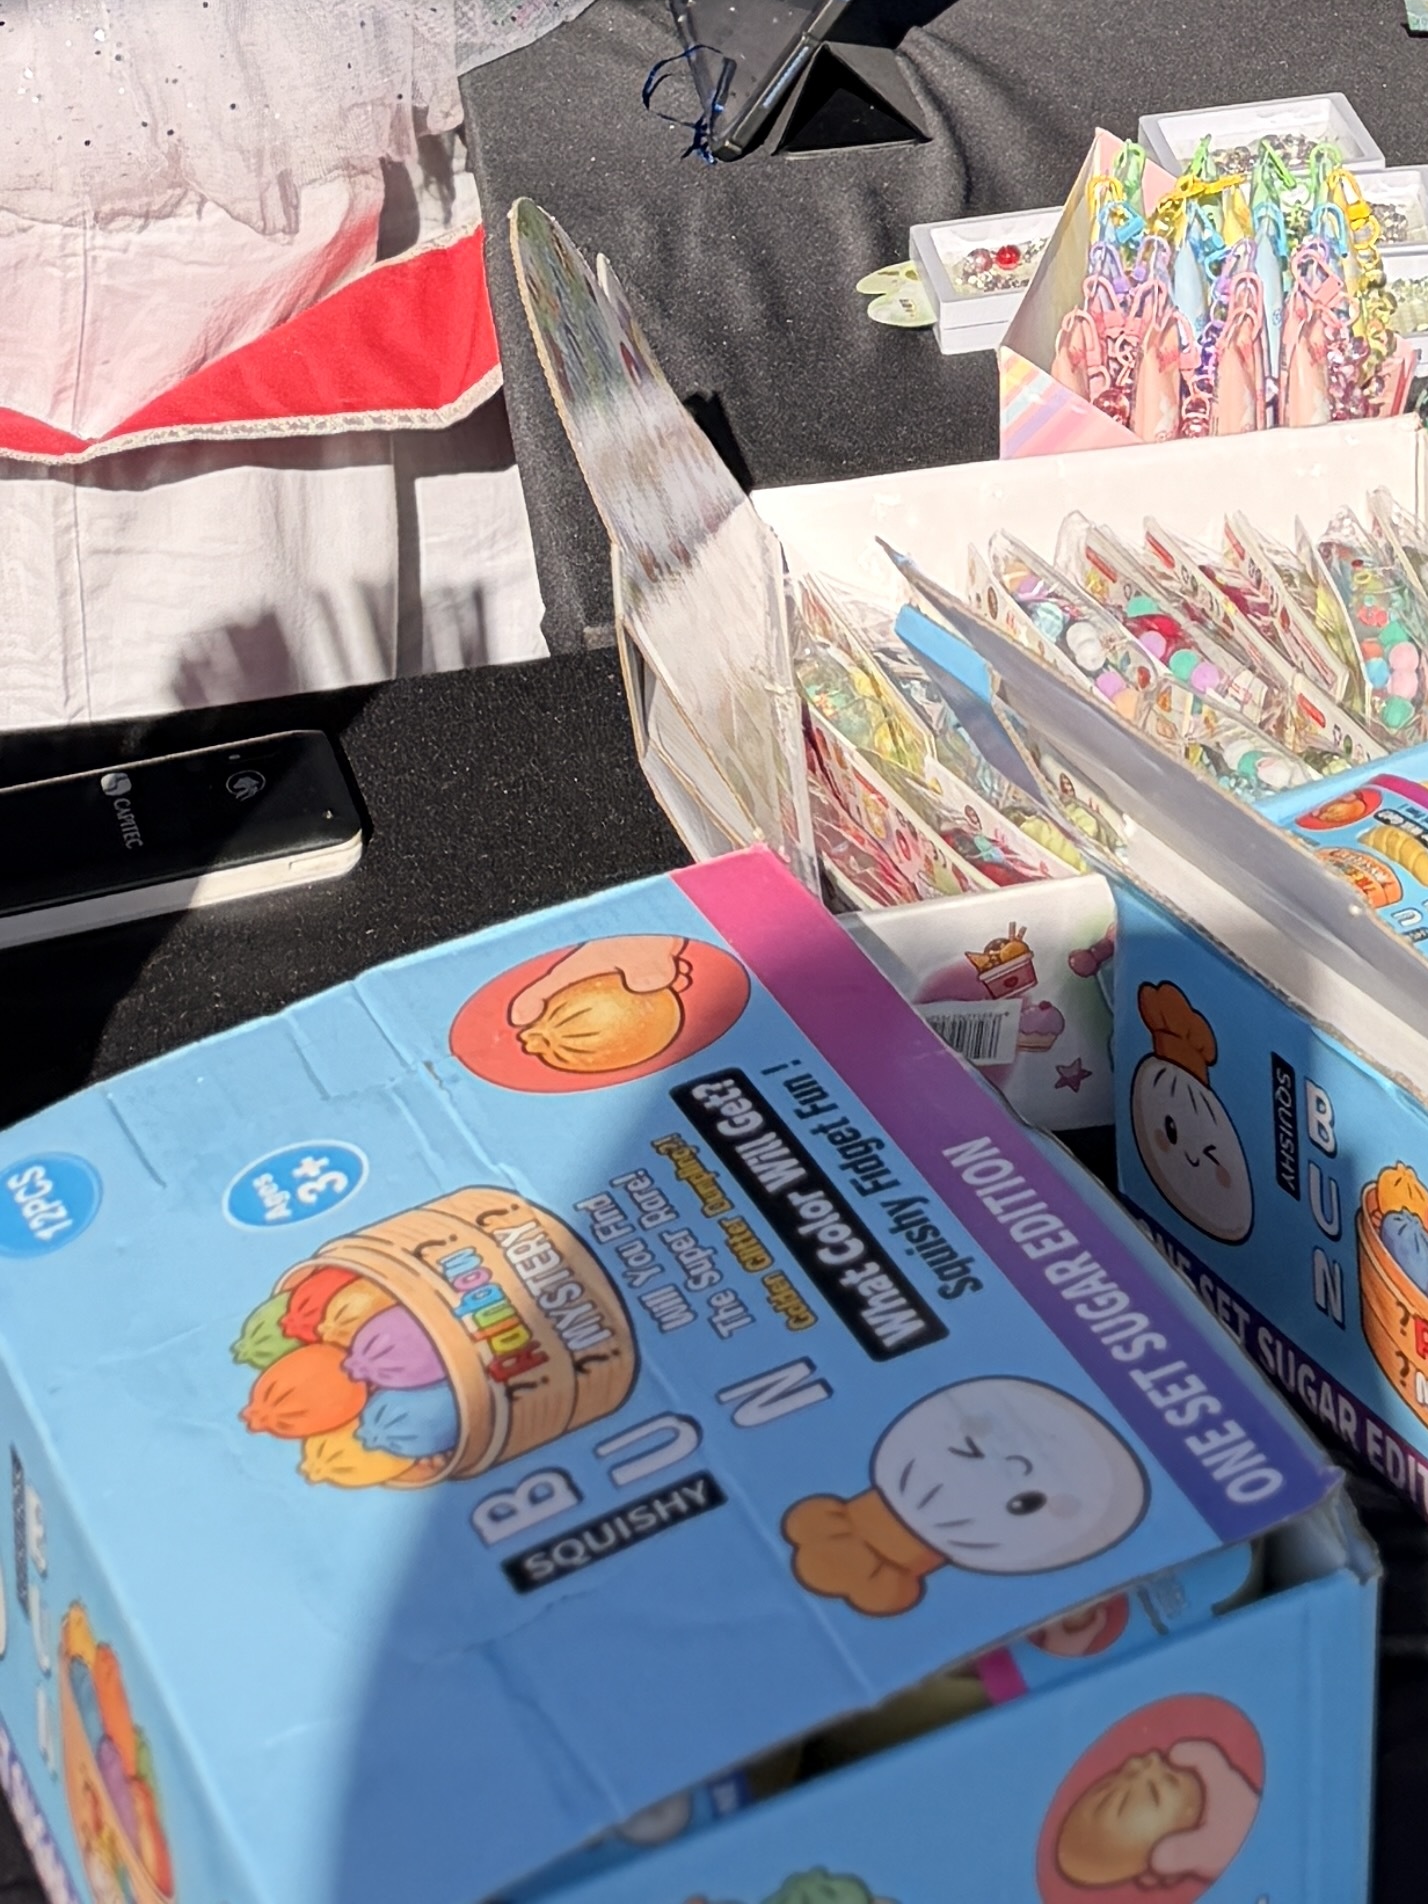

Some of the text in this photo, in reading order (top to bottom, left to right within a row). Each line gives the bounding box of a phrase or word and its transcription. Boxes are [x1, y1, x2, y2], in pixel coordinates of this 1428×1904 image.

[113, 797, 143, 850] CAPITEC
[782, 1072, 840, 1121] Fun
[1275, 1064, 1298, 1192] SQUISHY
[7, 1164, 73, 1241] 12PCS
[252, 1172, 293, 1223] Ages
[291, 1155, 349, 1205] 3+
[691, 1077, 927, 1350] What Color Will Get?
[809, 1114, 902, 1199] Fidget
[493, 1220, 616, 1354] MYSTERY
[574, 1194, 697, 1333] Will You Find
[610, 1168, 756, 1340] The Super Rare!
[881, 1195, 985, 1301] Squishy
[437, 1245, 550, 1382] Rainbow
[942, 1136, 1285, 1504] ONE SET SUGAR EDITION
[1199, 1275, 1250, 1348] SET
[1256, 1326, 1359, 1453] SUGAR
[523, 1479, 709, 1581] SQUISHY
